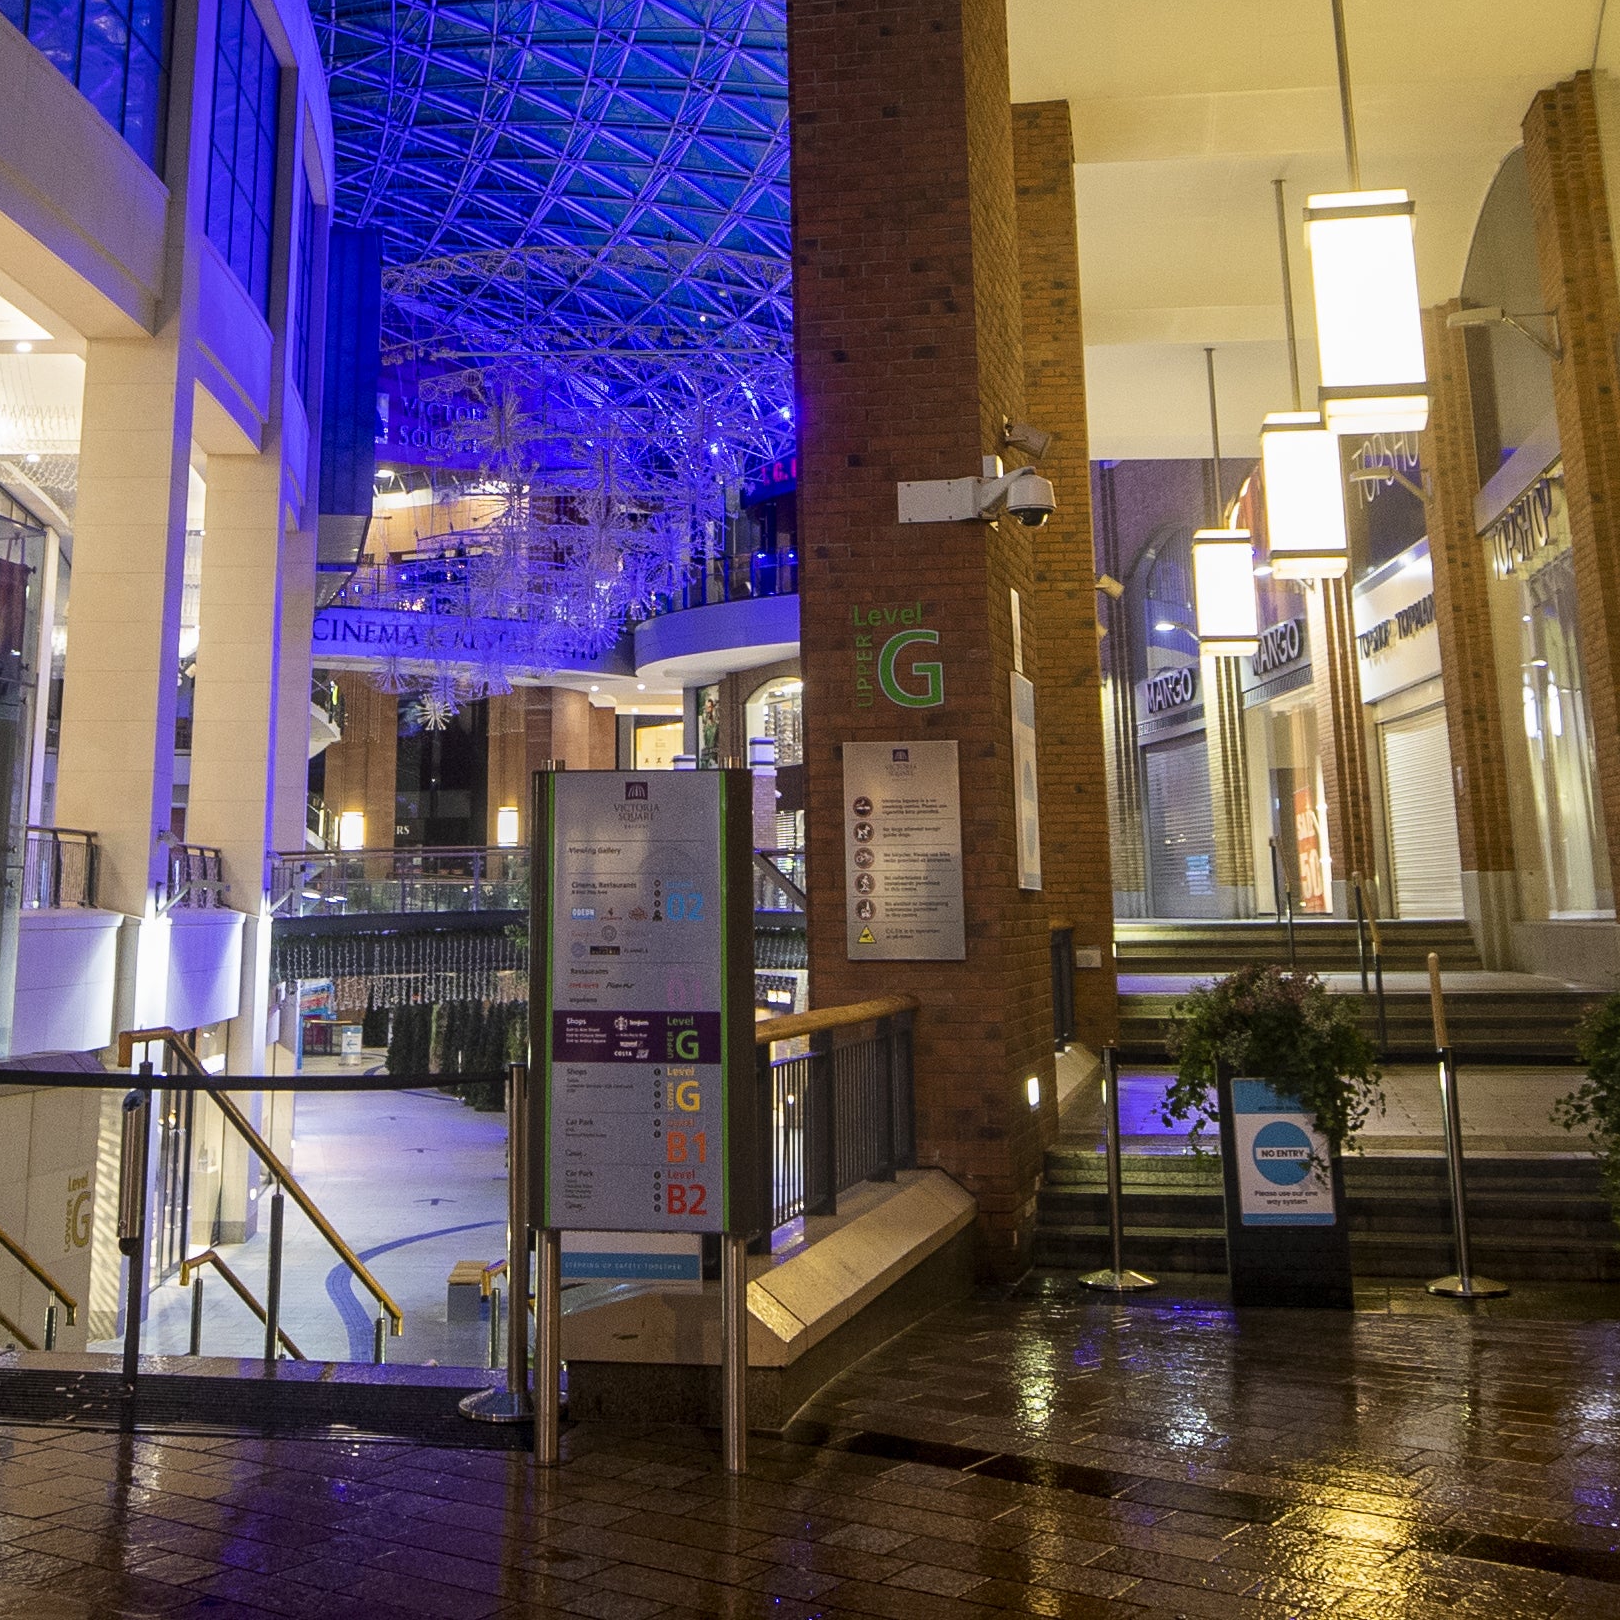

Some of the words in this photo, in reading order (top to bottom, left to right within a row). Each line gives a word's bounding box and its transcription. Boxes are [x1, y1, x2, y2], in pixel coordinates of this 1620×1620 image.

[1488, 478, 1552, 581] TOPSHOP
[852, 601, 923, 627] Level
[312, 617, 419, 646] CINEMA
[1358, 619, 1393, 661] TOPSHOP
[855, 634, 874, 709] UPPER
[878, 628, 944, 708] G
[1145, 668, 1196, 714] MANGO
[613, 803, 660, 813] VICTORIA
[597, 847, 621, 856] Gallery
[666, 892, 705, 922] 02
[566, 1017, 587, 1025] Shops
[666, 1016, 694, 1026] Level
[666, 1031, 674, 1059] UPPER
[675, 1030, 700, 1060] G
[666, 1067, 695, 1077] Level
[675, 1080, 701, 1112] G
[565, 1118, 579, 1126] Car
[579, 1118, 594, 1126] Park
[666, 1131, 707, 1164] B1
[1261, 1149, 1275, 1158] NO
[1276, 1149, 1305, 1158] ENTRY
[666, 1169, 696, 1180] Level
[666, 1183, 708, 1216] B2
[1254, 1190, 1277, 1198] Please
[1266, 1199, 1282, 1207] way
[1282, 1198, 1309, 1207] system
[71, 1190, 92, 1248] G
